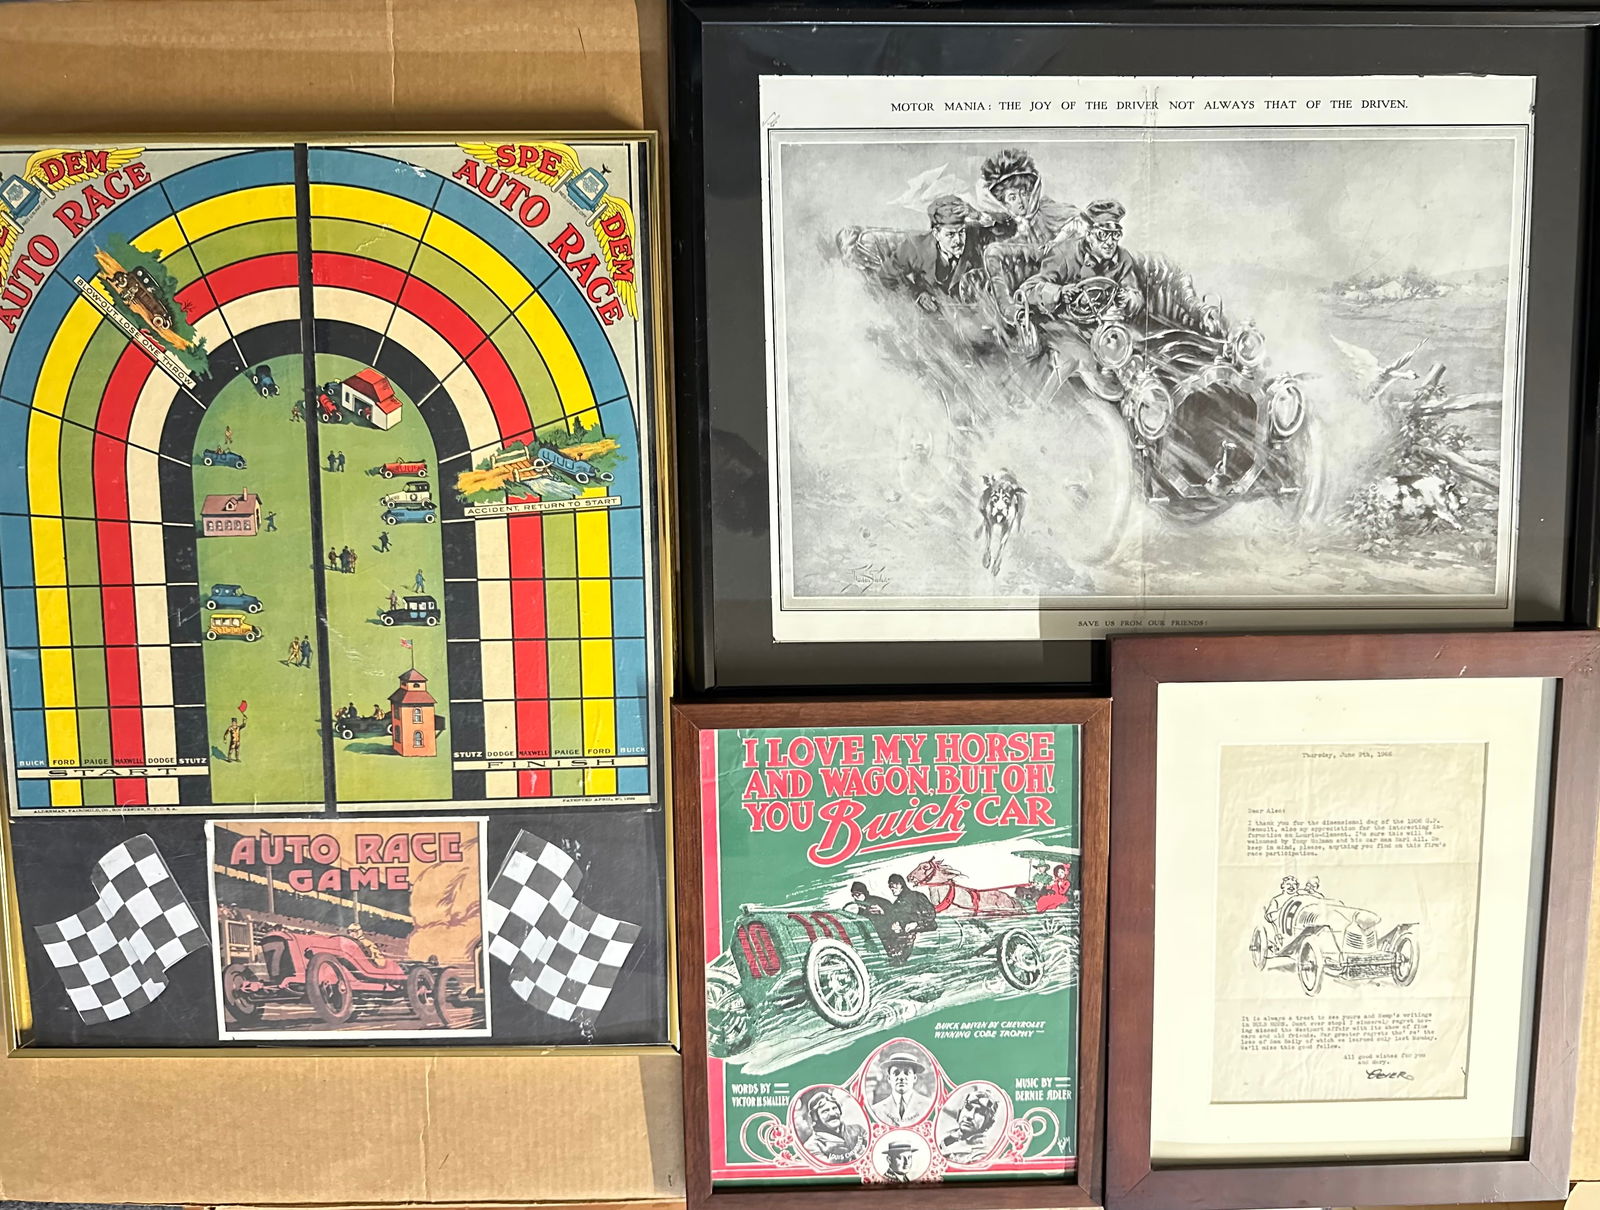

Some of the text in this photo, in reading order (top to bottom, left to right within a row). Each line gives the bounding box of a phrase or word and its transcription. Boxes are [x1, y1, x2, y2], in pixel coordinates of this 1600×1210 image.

[891, 102, 934, 111] MOTOR
[999, 102, 1021, 111] THE
[1030, 101, 1052, 111] JOY
[1061, 101, 1077, 111] OF
[1086, 101, 1108, 110] THE
[1116, 101, 1158, 110] DRIVER
[1170, 101, 1194, 110] NOT
[1204, 100, 1255, 110] ALWAYS
[1264, 100, 1296, 110] THAT
[1306, 100, 1321, 110] OF
[1330, 100, 1352, 110] THE
[1362, 100, 1408, 109] DRIVEN.
[40, 150, 109, 185] DEM
[495, 144, 563, 177] SPE
[0, 162, 151, 333] AUTO RACE
[452, 159, 624, 326] AUTO RACE
[600, 212, 635, 284] DEM
[119, 318, 140, 339] LOSE
[142, 339, 161, 357] ONE
[162, 356, 193, 386] THROW
[468, 505, 520, 514] ACCIDENT,
[524, 502, 566, 510] RETURN
[585, 498, 618, 506] START
[488, 758, 616, 768] FINISH
[743, 731, 1055, 768] I LOVE MY HORSE
[48, 768, 178, 776] START
[742, 763, 1055, 799] AND WAGON, BUT OH!
[230, 828, 463, 866] AUTO RACE
[742, 795, 1055, 867] YOU Buick CAR
[288, 868, 410, 892] GAME
[262, 942, 284, 976] 7
[738, 920, 780, 978] 10
[934, 1022, 960, 1030] BUICK
[988, 1021, 998, 1029] BY
[1000, 1029, 1034, 1037] TROPHY
[732, 1083, 771, 1094] WORDS BY
[1015, 1077, 1052, 1088] MUSIC BY
[1015, 1090, 1072, 1101] BERNIE ADLER
[732, 1096, 756, 1107] VICTOR
[763, 1096, 790, 1106] SMALLEY
